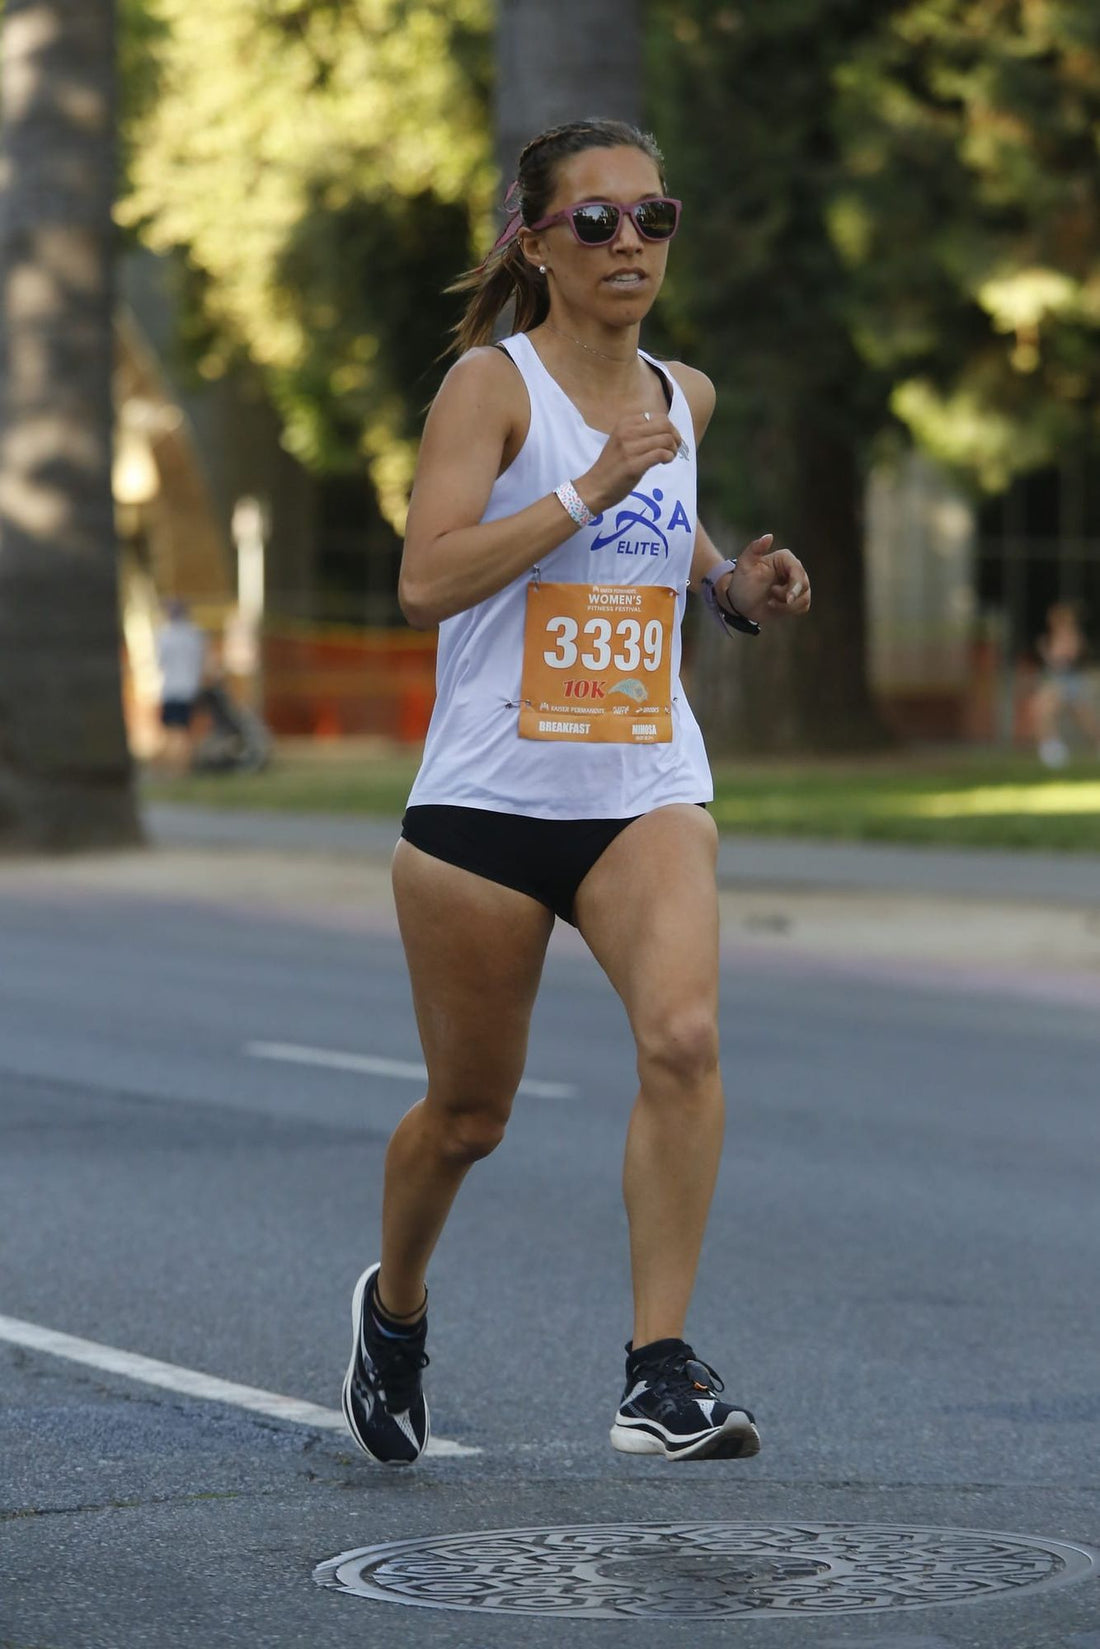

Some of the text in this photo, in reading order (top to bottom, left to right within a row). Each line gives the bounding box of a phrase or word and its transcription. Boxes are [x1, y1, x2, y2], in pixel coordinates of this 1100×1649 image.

[616, 541, 661, 556] ELITE
[588, 594, 642, 605] WOMEN'S
[543, 616, 663, 672] 3339
[563, 679, 607, 699] 10K
[539, 721, 591, 735] BREAKFAST
